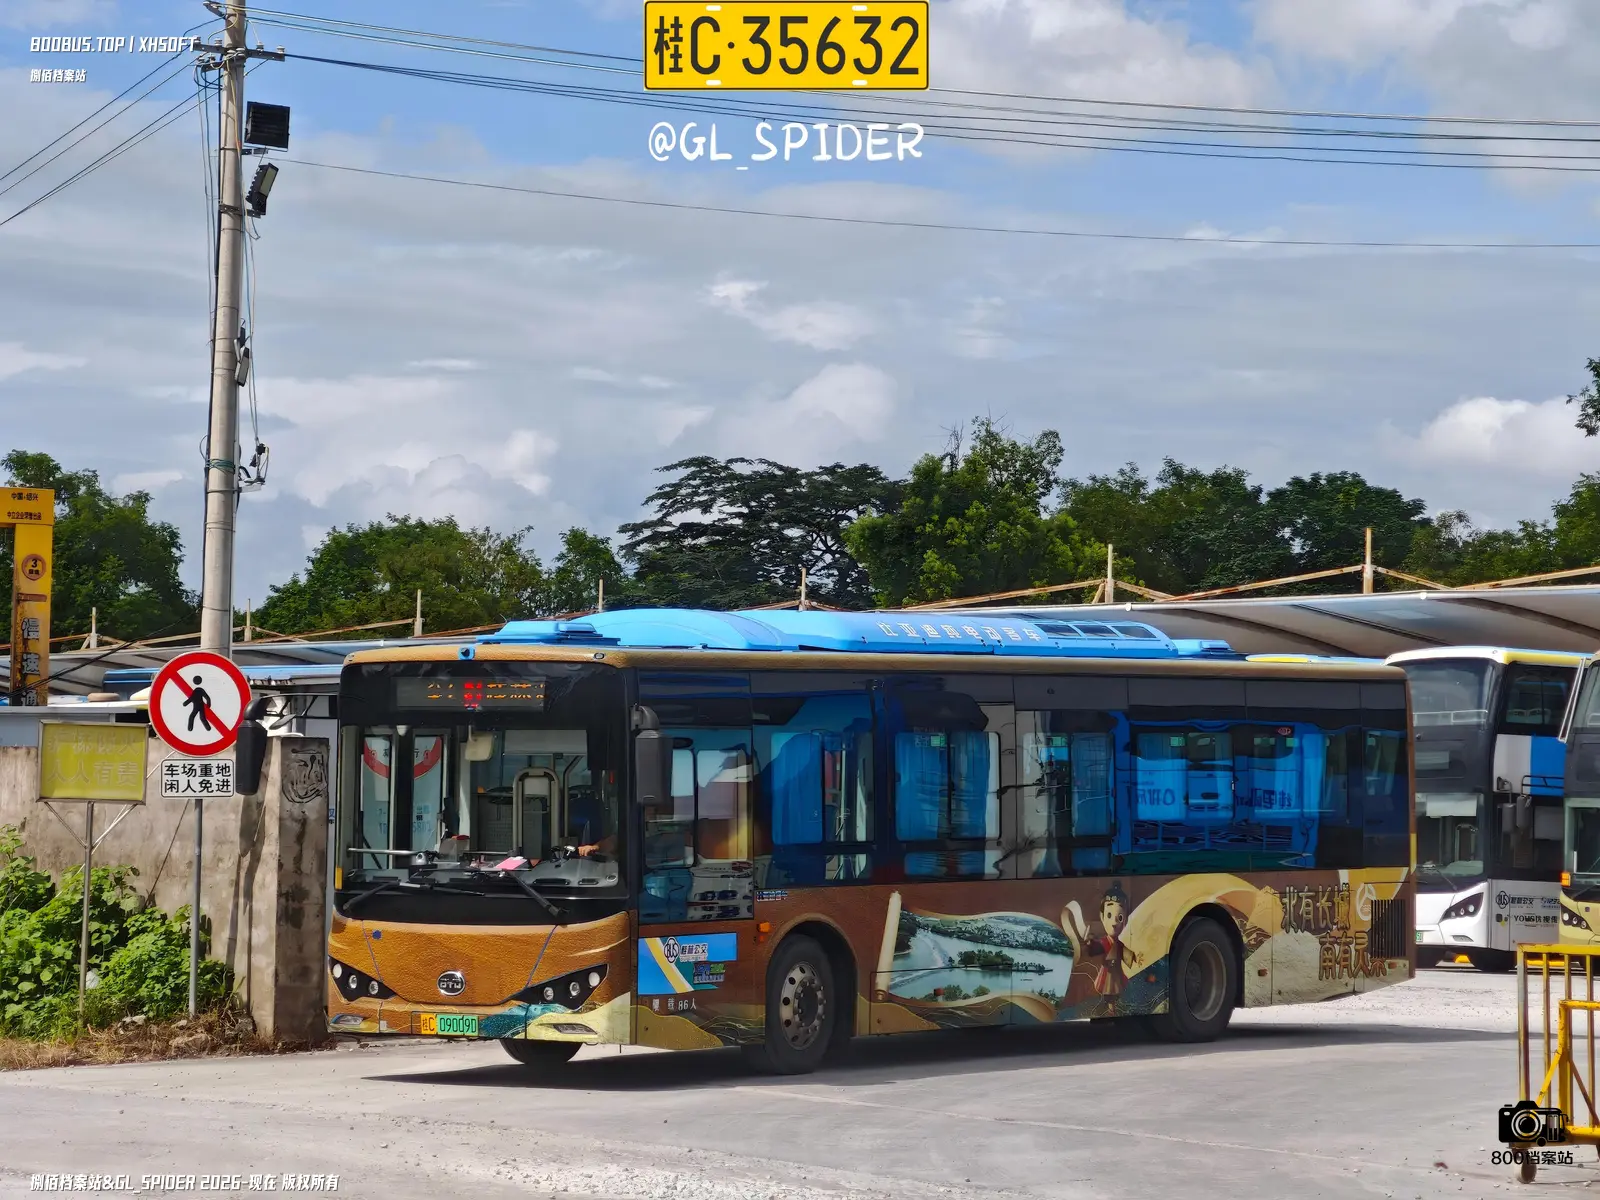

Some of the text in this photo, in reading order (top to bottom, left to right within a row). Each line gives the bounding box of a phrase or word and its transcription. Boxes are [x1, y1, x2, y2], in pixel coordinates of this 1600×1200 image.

[31, 558, 38, 568] 3
[47, 760, 139, 787] 人人有责
[163, 763, 232, 778] 车场重地
[163, 779, 232, 794] 闲人免进
[1281, 883, 1350, 934] 北有长城
